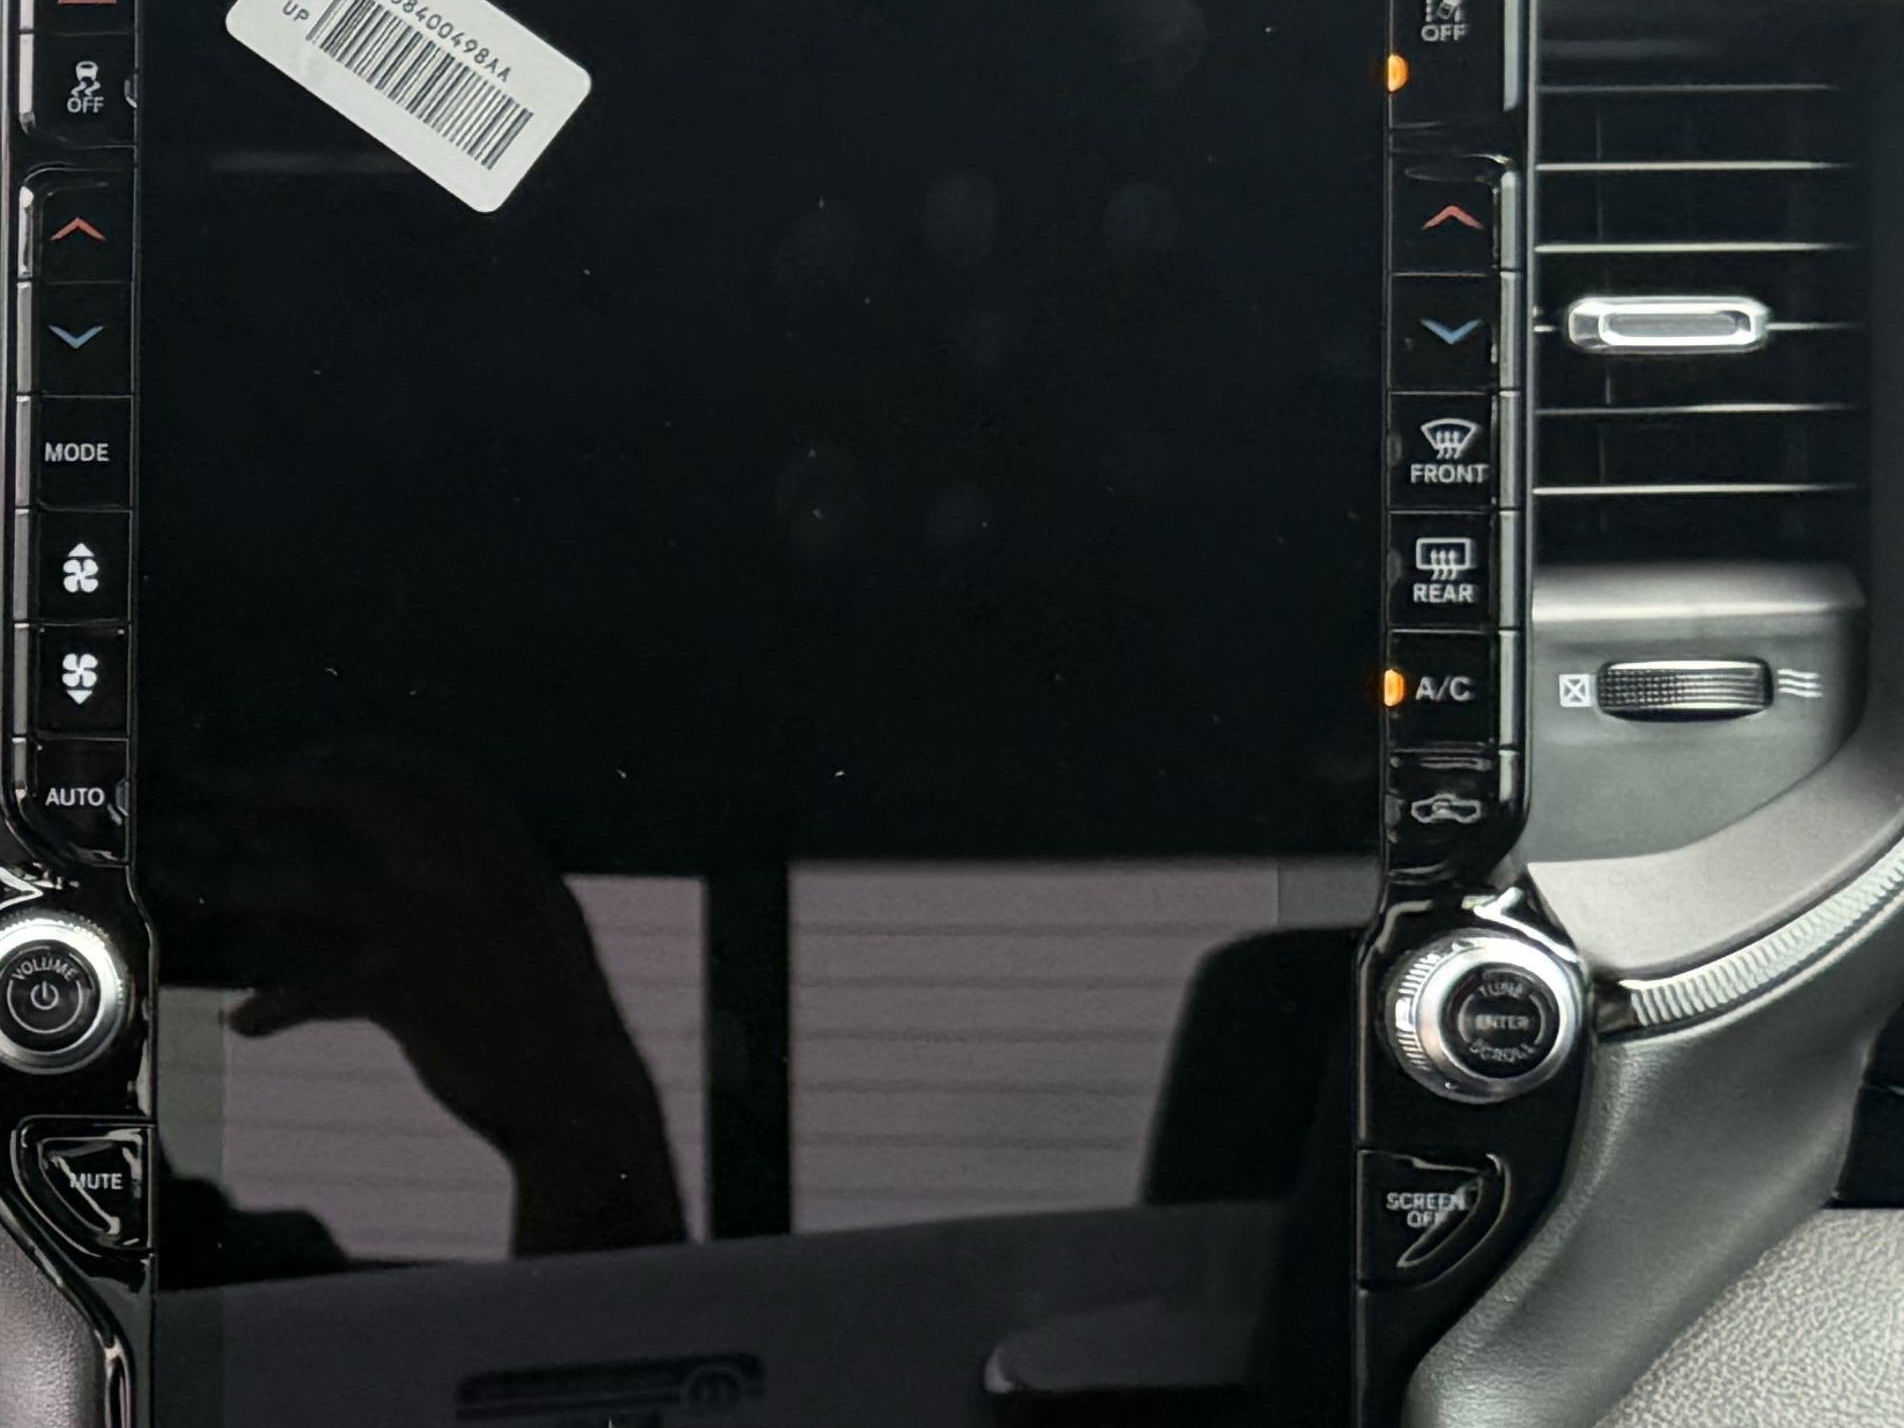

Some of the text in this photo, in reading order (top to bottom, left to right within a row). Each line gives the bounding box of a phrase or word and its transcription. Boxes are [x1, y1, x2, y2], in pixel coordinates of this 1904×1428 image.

[282, 0, 311, 22] UP
[1421, 24, 1467, 42] OFF
[67, 97, 104, 113] OFF
[44, 442, 110, 462] MODE
[1410, 464, 1488, 484] FRONT
[1413, 583, 1474, 603] REAR
[1415, 676, 1473, 702] A/C
[45, 787, 106, 807] AUTO
[12, 957, 77, 982] VOLUME
[70, 1173, 123, 1190] MUTE
[1386, 1192, 1466, 1211] SCREEN
